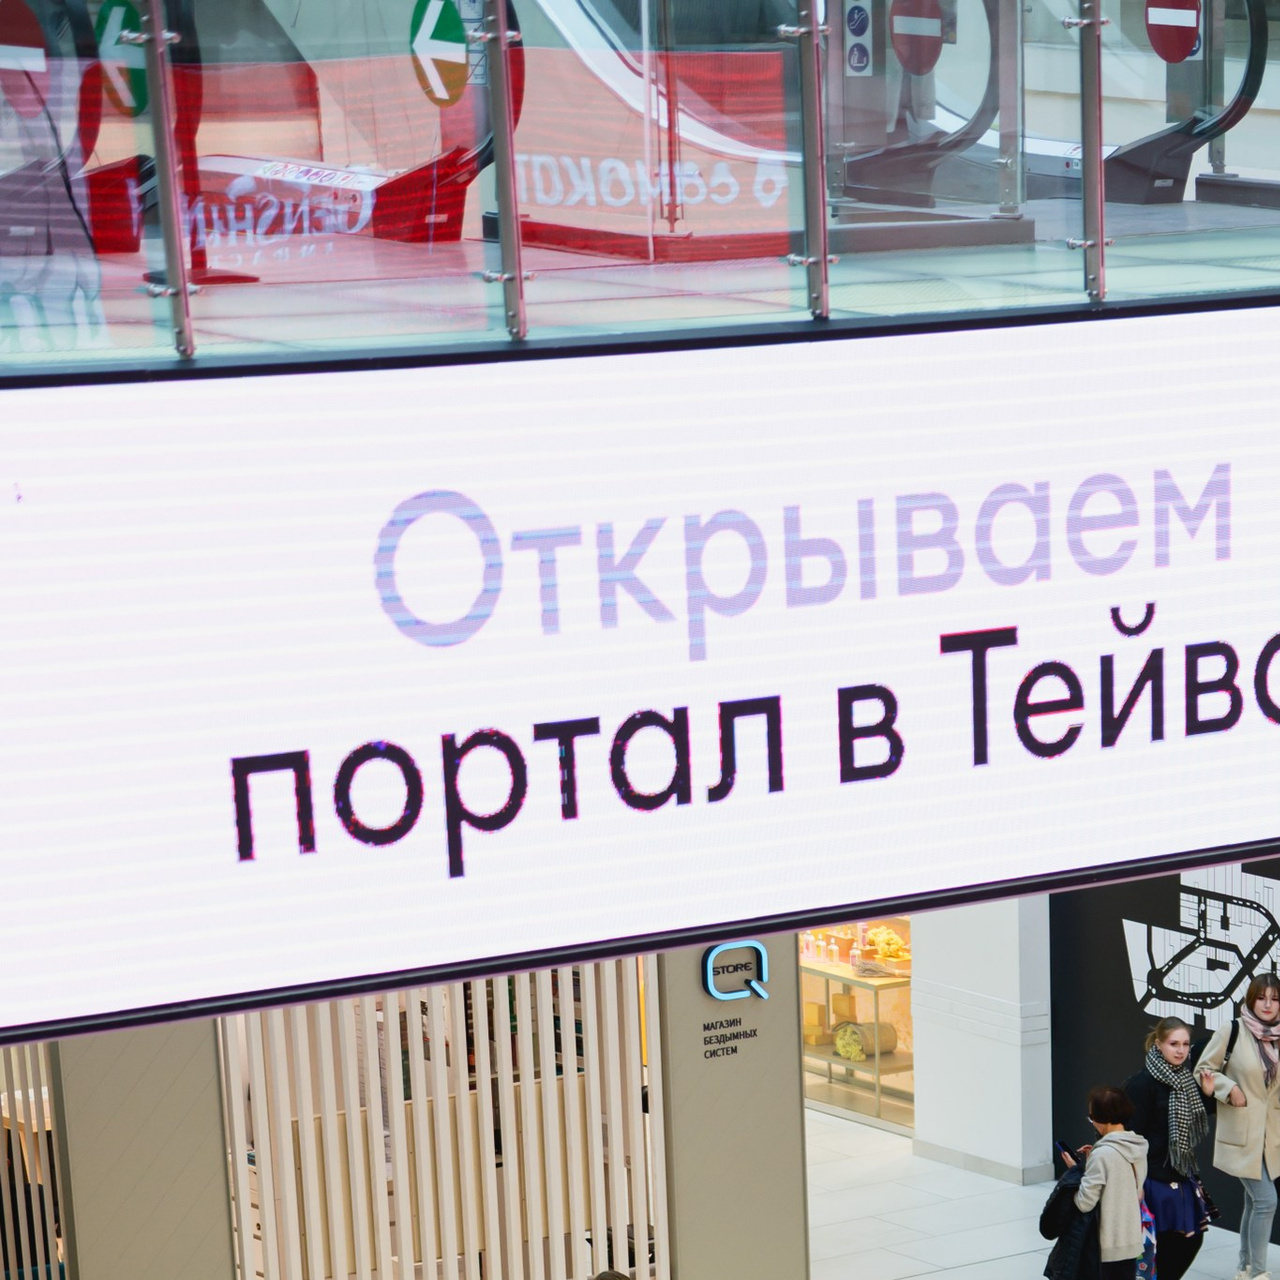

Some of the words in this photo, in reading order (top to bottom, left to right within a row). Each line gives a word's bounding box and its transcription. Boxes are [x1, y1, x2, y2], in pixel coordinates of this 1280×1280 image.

[373, 462, 1234, 662] Открываем
[229, 692, 786, 878] портал
[836, 683, 904, 785] в
[712, 961, 753, 976] STORE
[703, 1017, 742, 1032] МАГАЗИН
[703, 1028, 758, 1046] БЕЗДЫМНЫХ
[703, 1045, 738, 1060] СИСТЕМ
